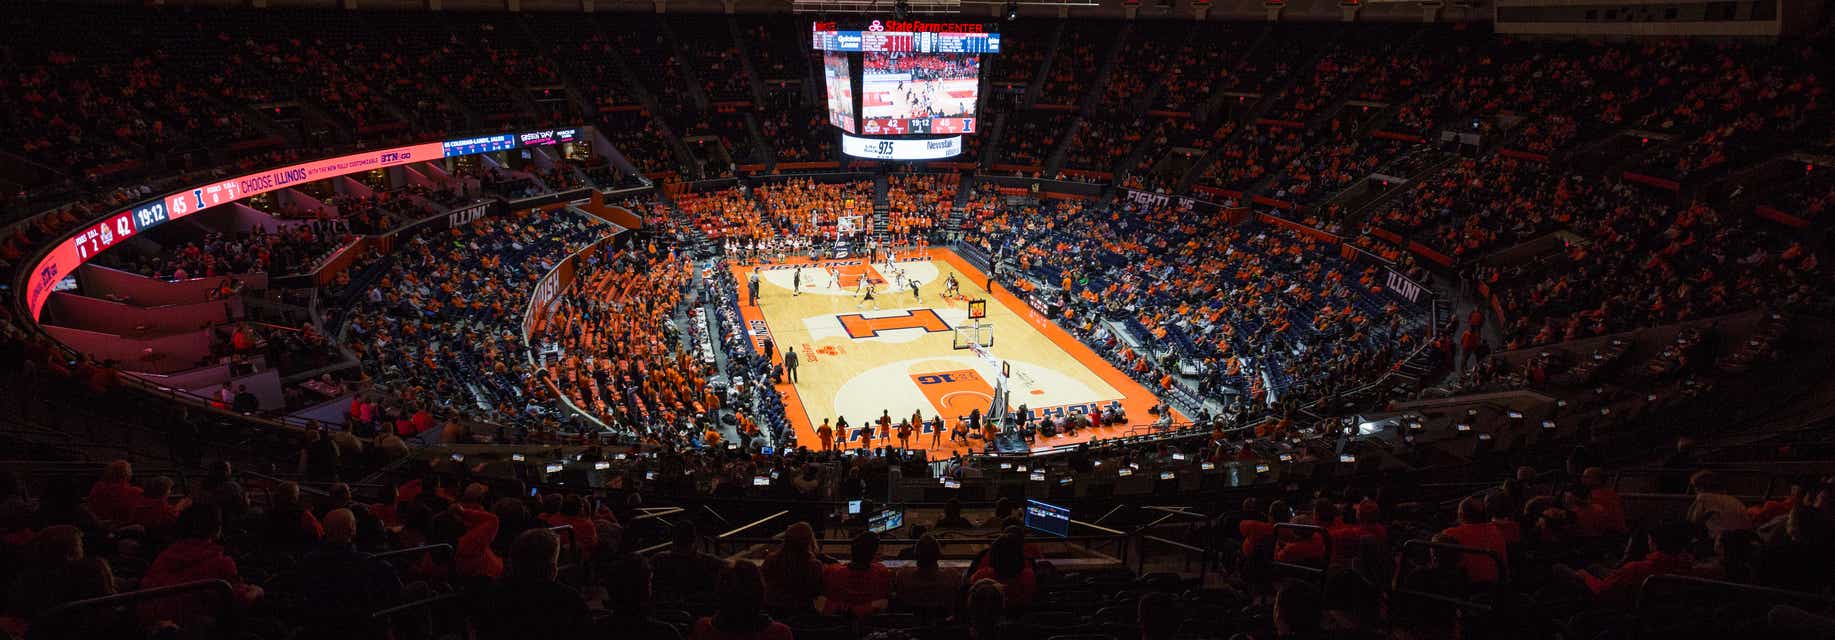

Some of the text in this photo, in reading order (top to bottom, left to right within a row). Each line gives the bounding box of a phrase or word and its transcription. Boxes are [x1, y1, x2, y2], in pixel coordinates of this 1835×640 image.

[885, 21, 983, 34] State Farm CENTER
[887, 120, 898, 128] 42
[911, 119, 930, 127] 19:12
[241, 175, 273, 194] CHOOSE
[274, 167, 307, 185] ILLINOIS
[172, 196, 187, 214] 45
[116, 203, 165, 237] 42 19:12
[449, 205, 487, 227] ILLINI
[1386, 272, 1421, 304] ILLINI
